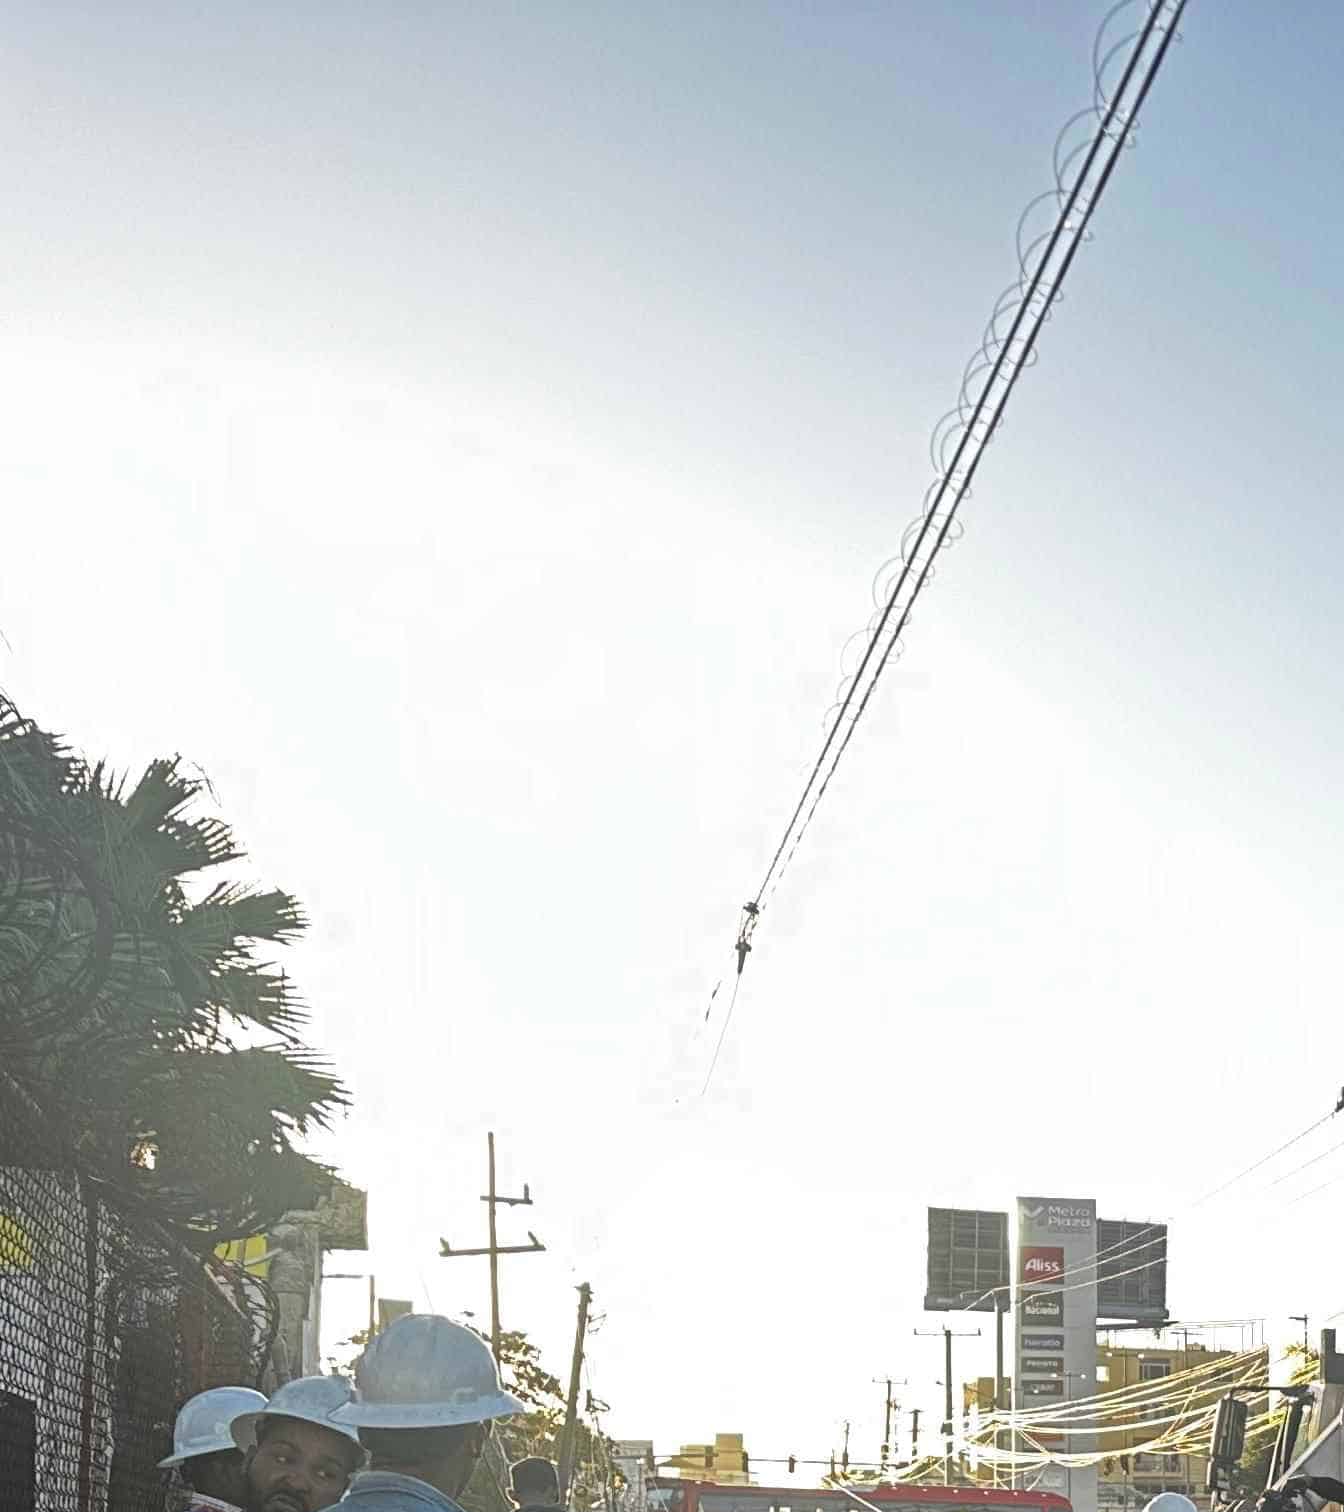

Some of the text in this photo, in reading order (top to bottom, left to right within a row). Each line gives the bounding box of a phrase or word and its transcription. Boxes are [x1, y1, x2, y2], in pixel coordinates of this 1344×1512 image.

[1047, 1205, 1090, 1217] Metro
[1047, 1216, 1091, 1228] Plaza
[1025, 1258, 1061, 1273] Aliss
